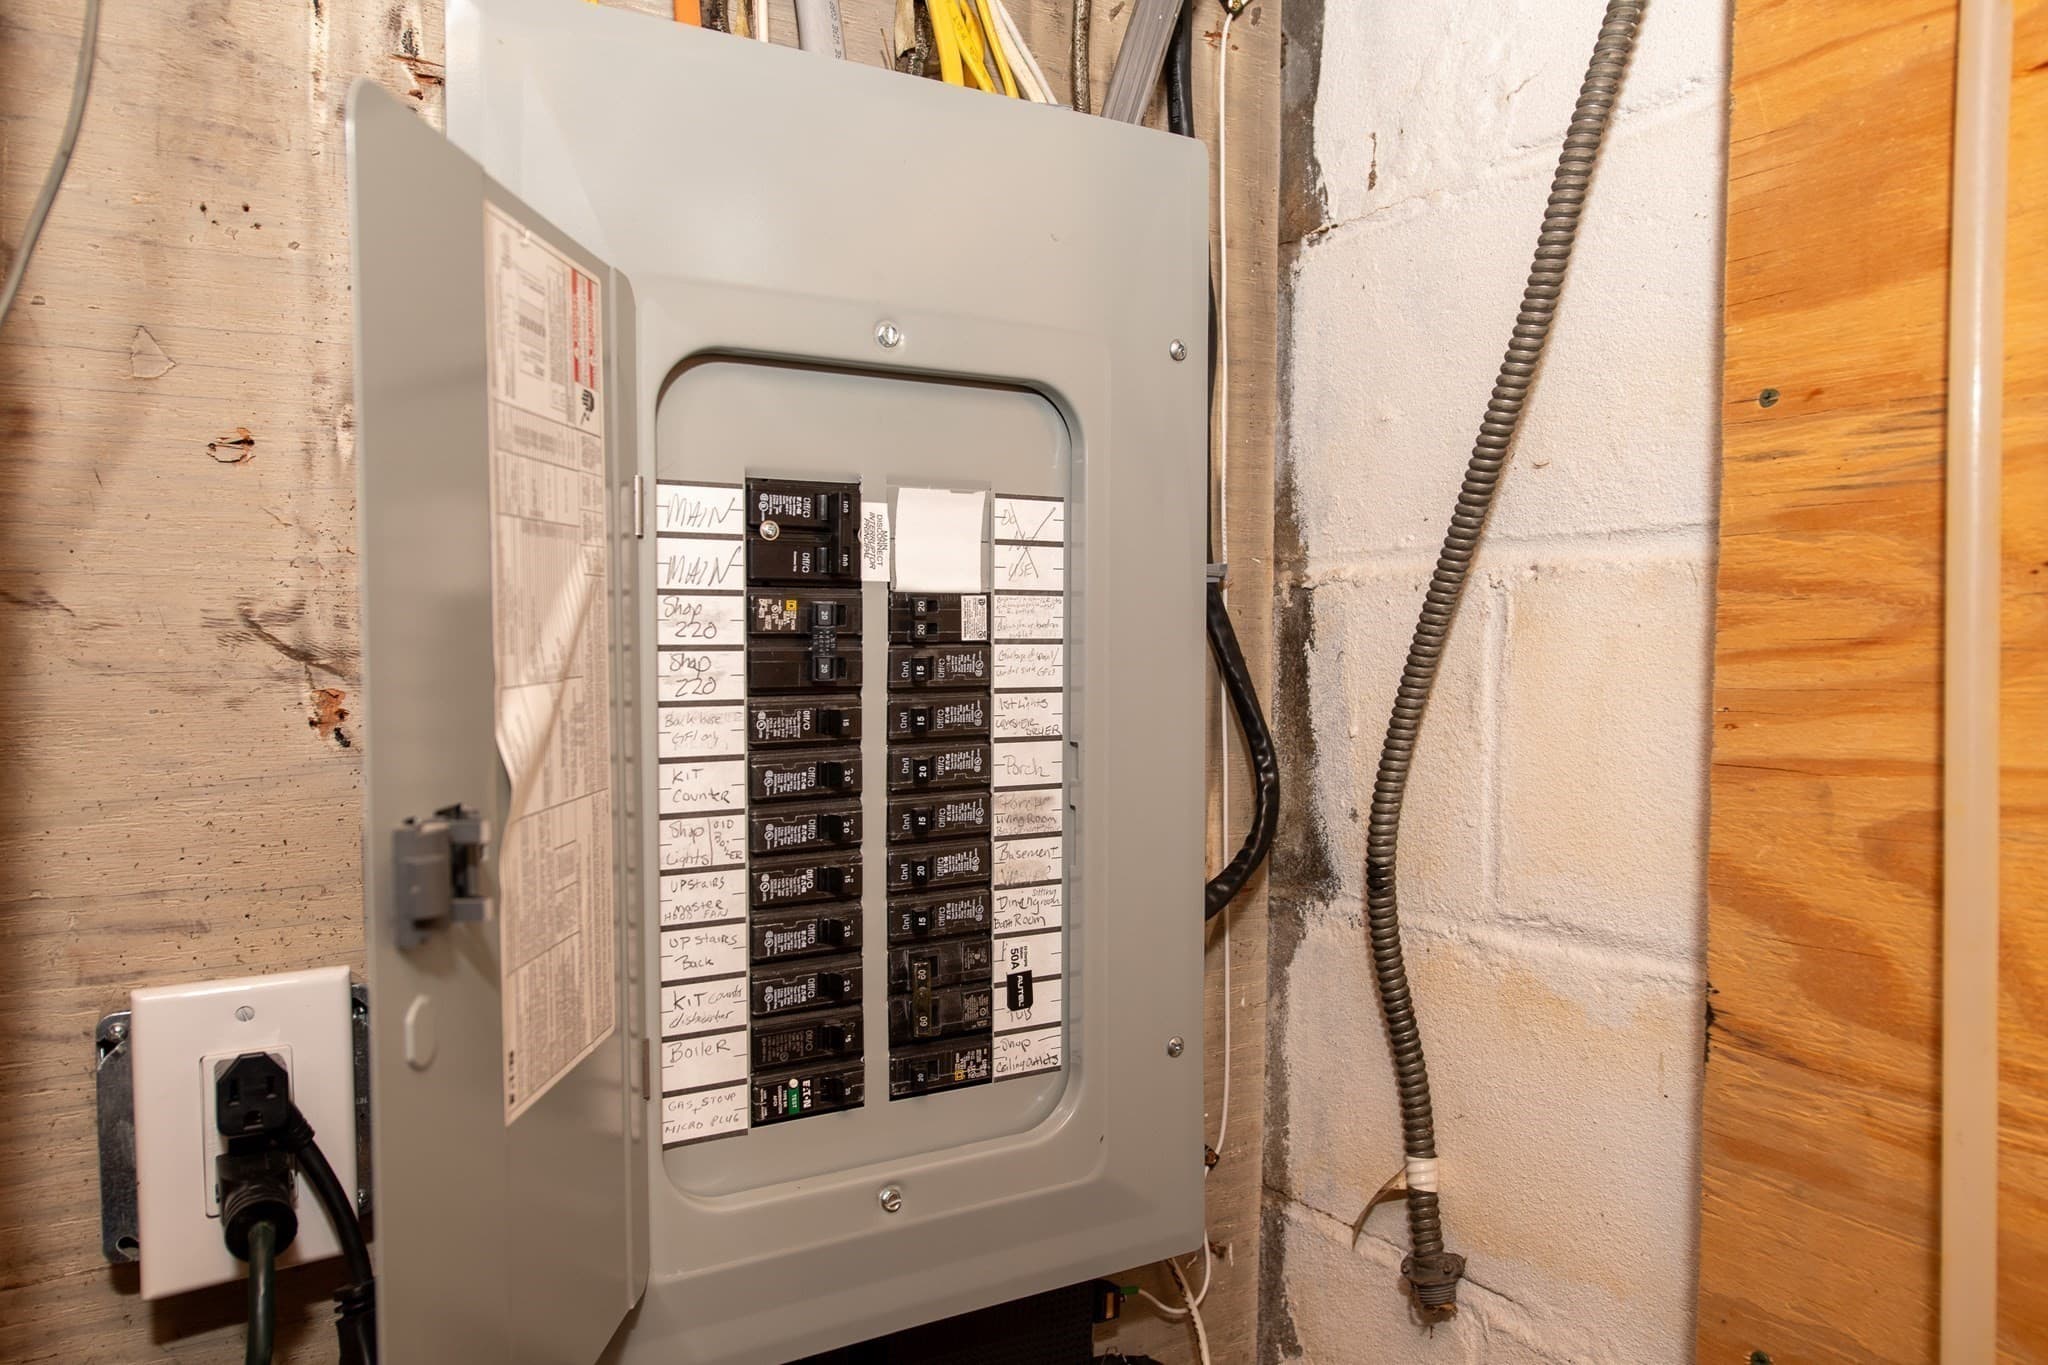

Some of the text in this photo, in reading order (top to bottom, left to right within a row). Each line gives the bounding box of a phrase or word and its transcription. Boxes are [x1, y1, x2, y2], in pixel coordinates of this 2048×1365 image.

[666, 494, 735, 528] MAIN
[666, 546, 741, 586] MAIN
[663, 596, 702, 626] Shop
[918, 601, 925, 612] 20
[675, 622, 717, 639] 220
[918, 624, 925, 635] 20
[917, 665, 924, 675] 15
[675, 676, 717, 697] 220
[917, 716, 924, 725] 15
[919, 766, 926, 777] 20
[1003, 755, 1050, 777] Porch
[672, 768, 704, 783] KIT
[844, 770, 850, 782] 20
[918, 816, 926, 825] 15
[843, 822, 850, 833] 20
[917, 866, 925, 876] 20
[844, 875, 851, 883] 15
[919, 917, 926, 926] 15
[844, 925, 851, 937] 20
[1011, 948, 1019, 970] 50A
[919, 1016, 927, 1027] 60
